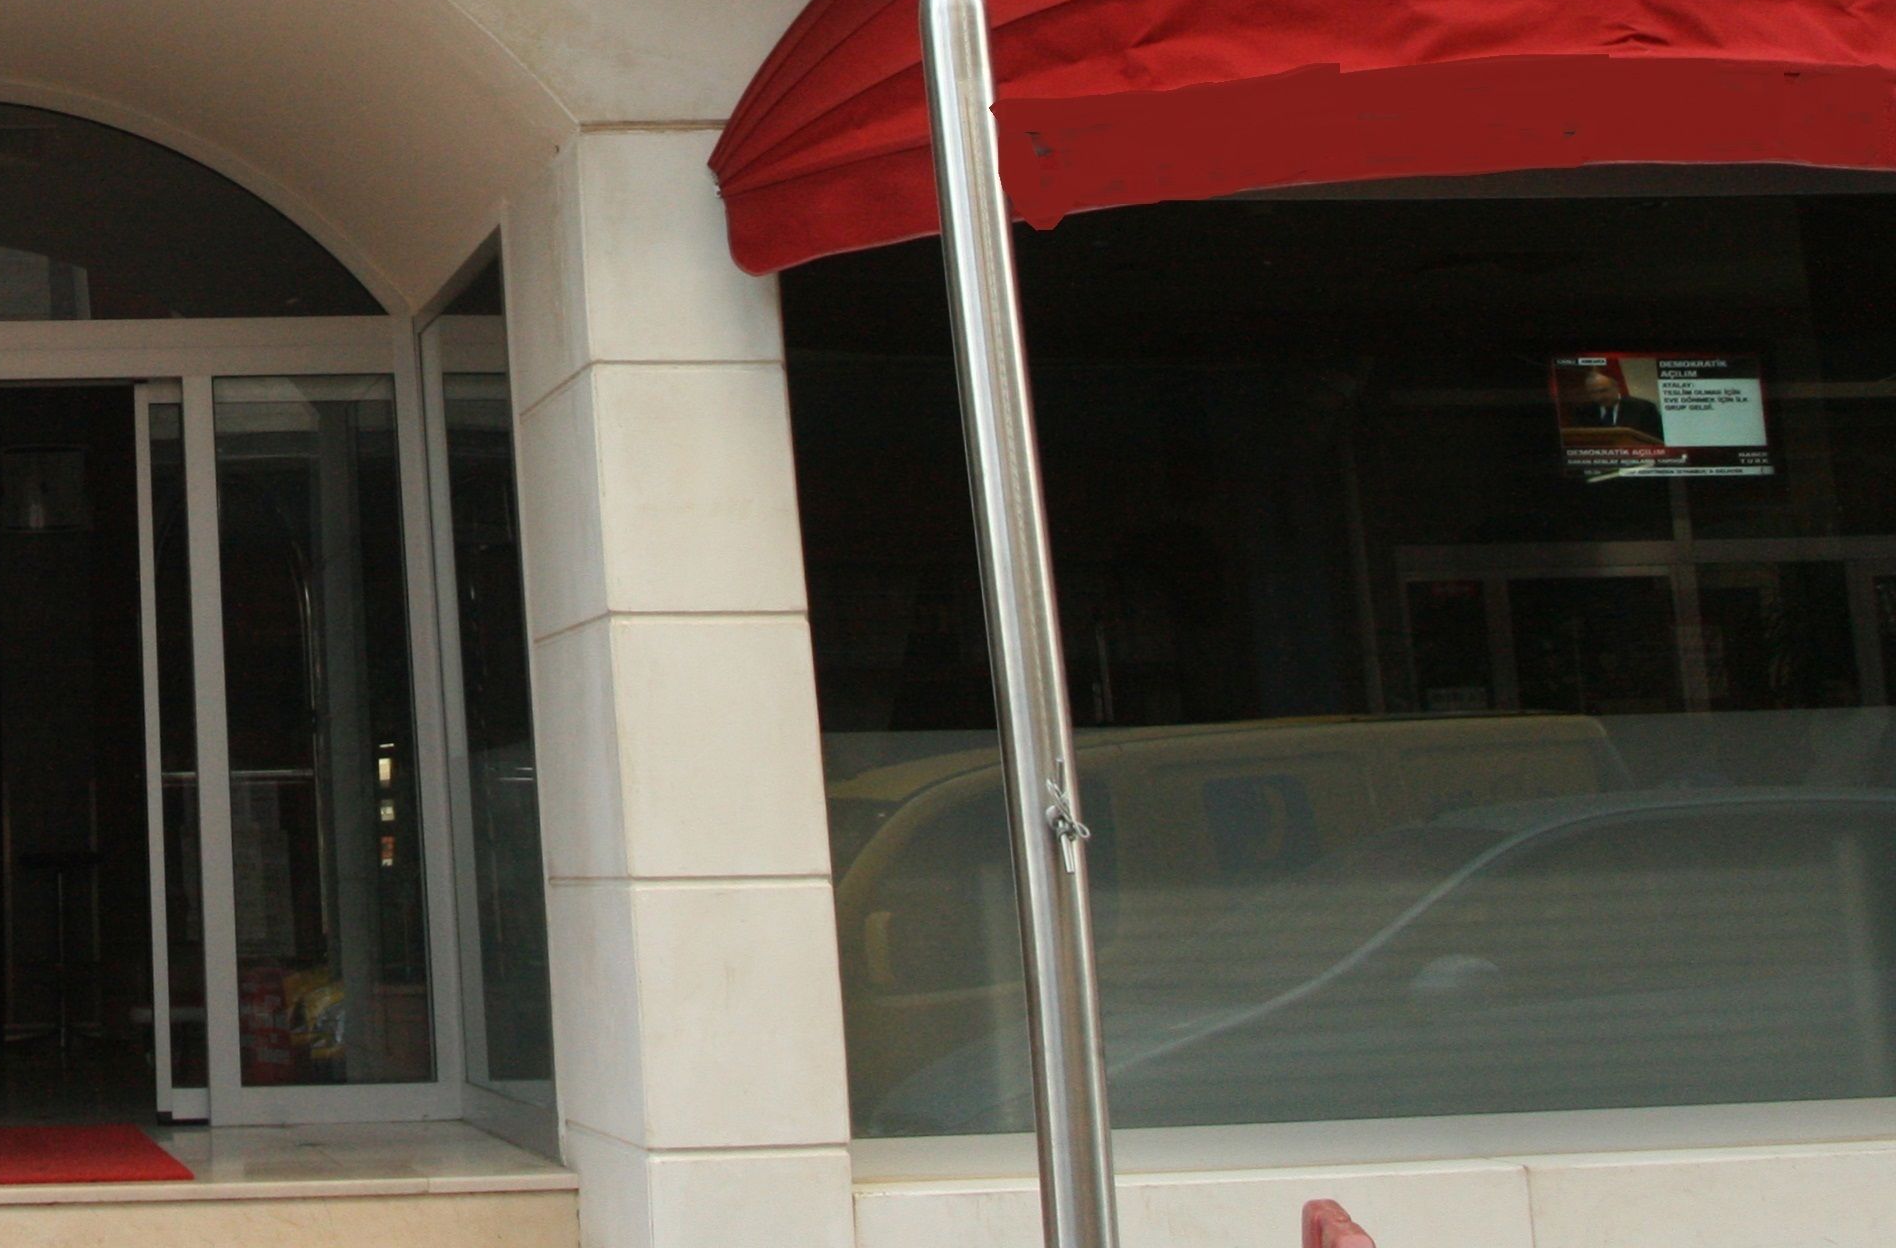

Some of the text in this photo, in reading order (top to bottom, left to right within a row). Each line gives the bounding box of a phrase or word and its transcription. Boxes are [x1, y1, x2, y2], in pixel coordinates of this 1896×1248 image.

[1659, 359, 1727, 368] DEMOKRATİK
[1661, 370, 1698, 379] AÇILIM
[1566, 448, 1629, 456] DEMOKRATİK
